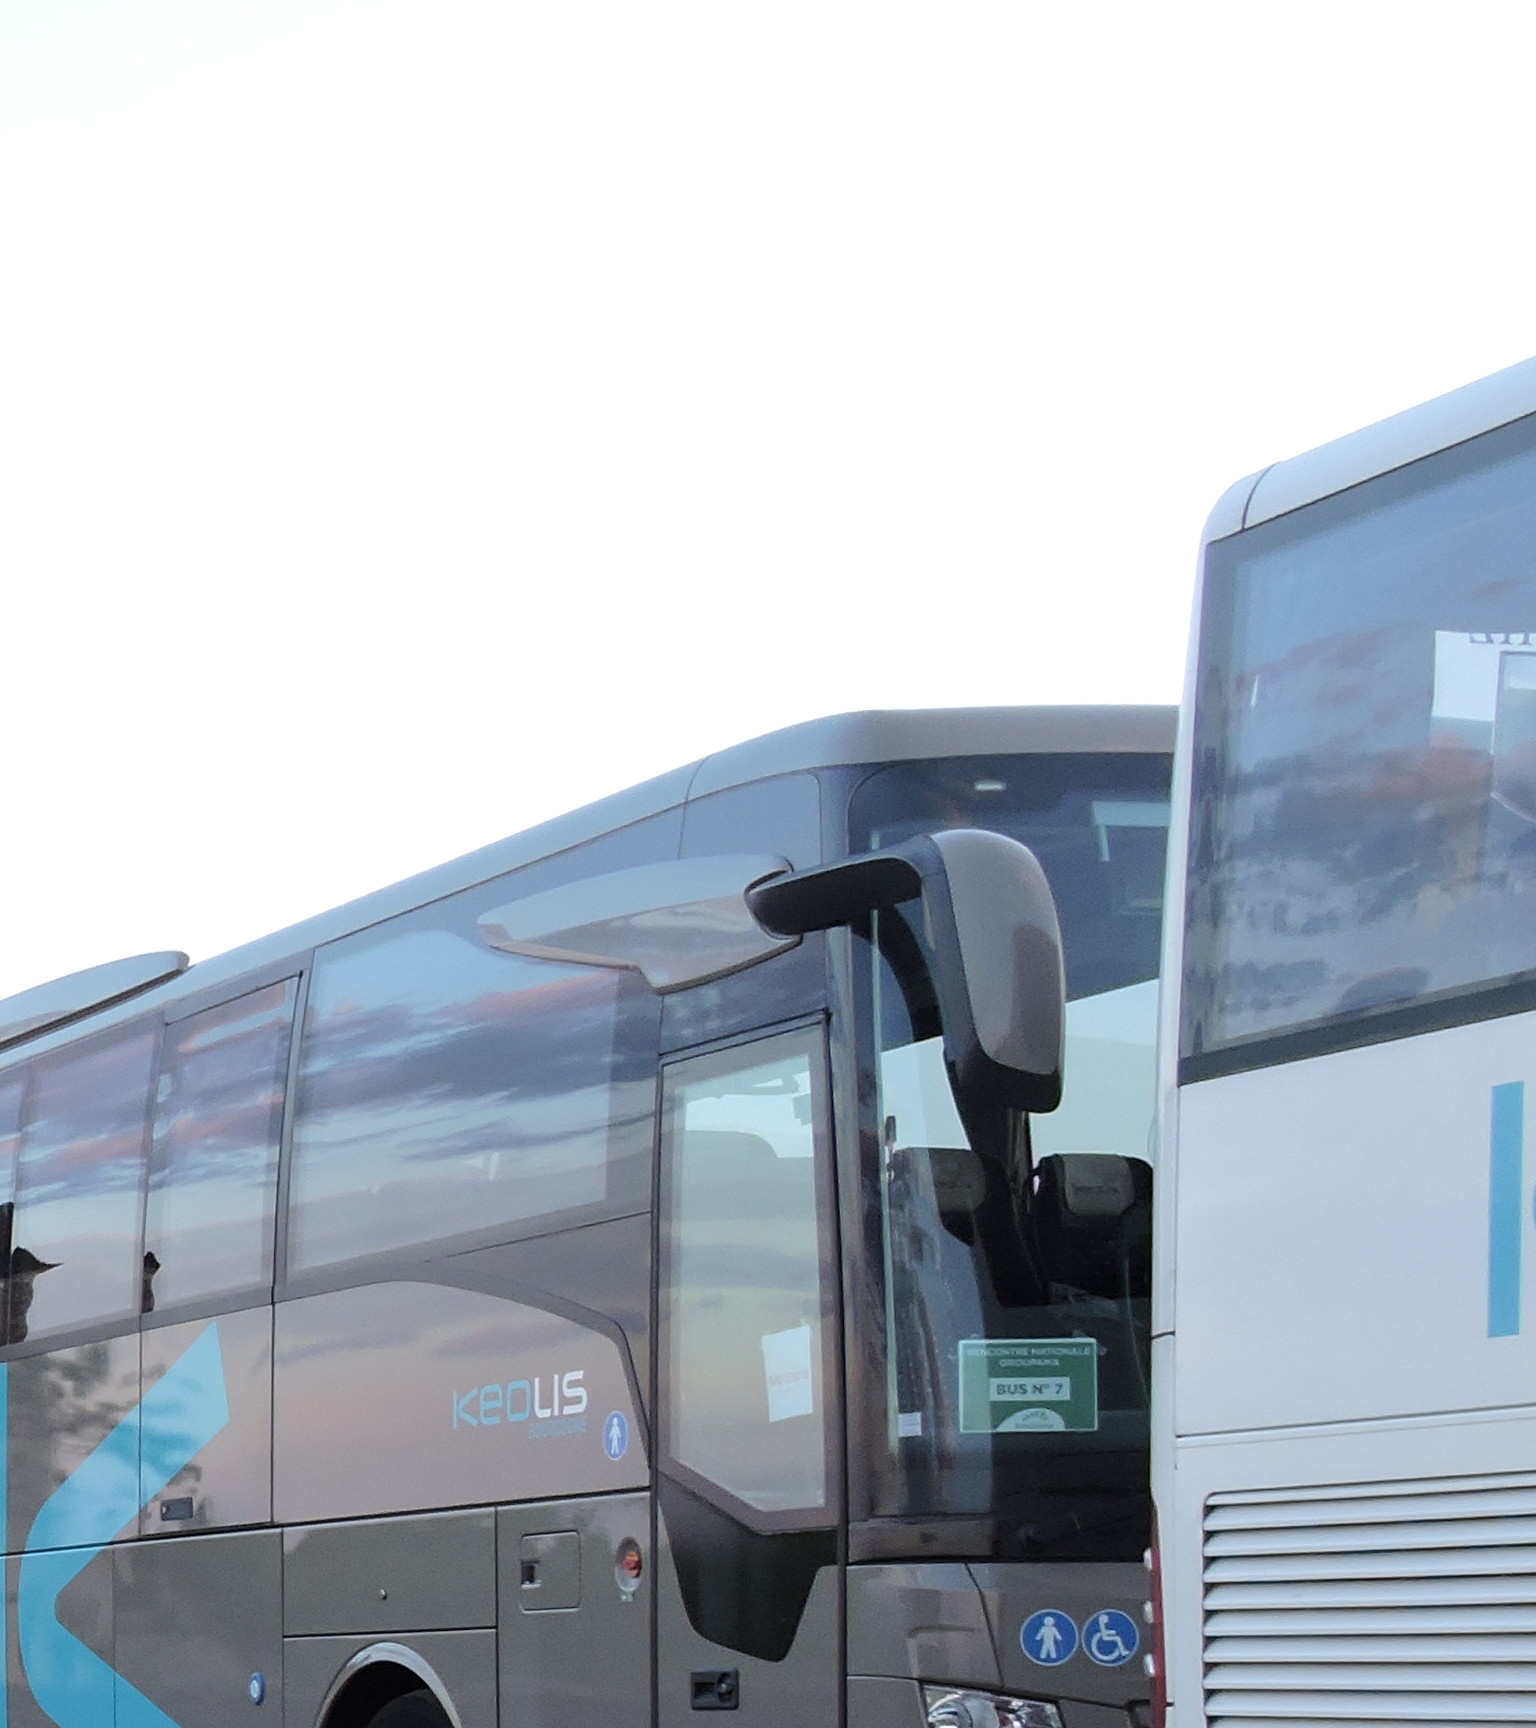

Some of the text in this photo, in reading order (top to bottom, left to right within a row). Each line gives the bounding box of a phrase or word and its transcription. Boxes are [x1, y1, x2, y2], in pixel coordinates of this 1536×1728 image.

[996, 1383, 1063, 1395] BUS N° 7
